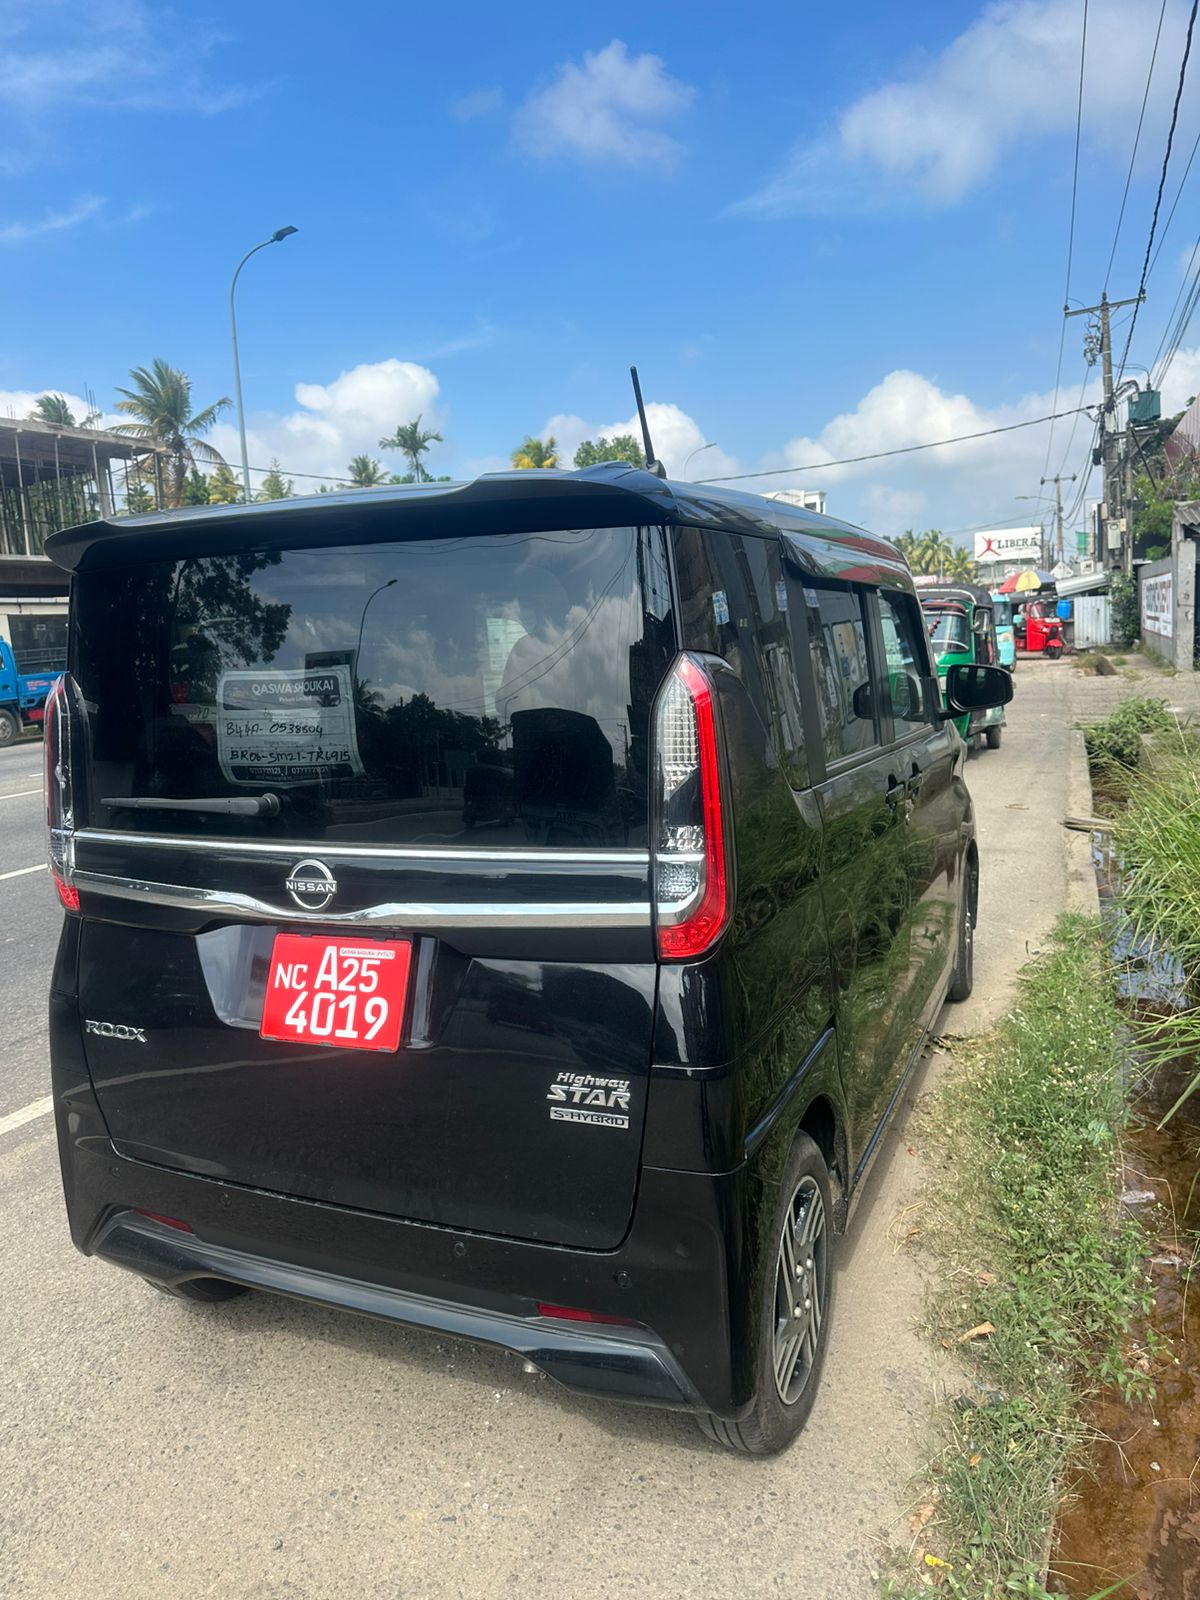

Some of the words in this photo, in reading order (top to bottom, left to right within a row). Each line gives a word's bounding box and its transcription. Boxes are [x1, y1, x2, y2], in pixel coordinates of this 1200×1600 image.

[251, 683, 292, 695] QASWA
[293, 679, 334, 694] SHOUKAI
[285, 881, 336, 892] NISSAN
[274, 962, 308, 990] NC
[284, 991, 389, 1040] 4019
[85, 1019, 148, 1043] ROOX
[556, 1072, 630, 1092] Highway
[546, 1084, 631, 1111] STAR
[554, 1110, 625, 1126] S-HYBRID
